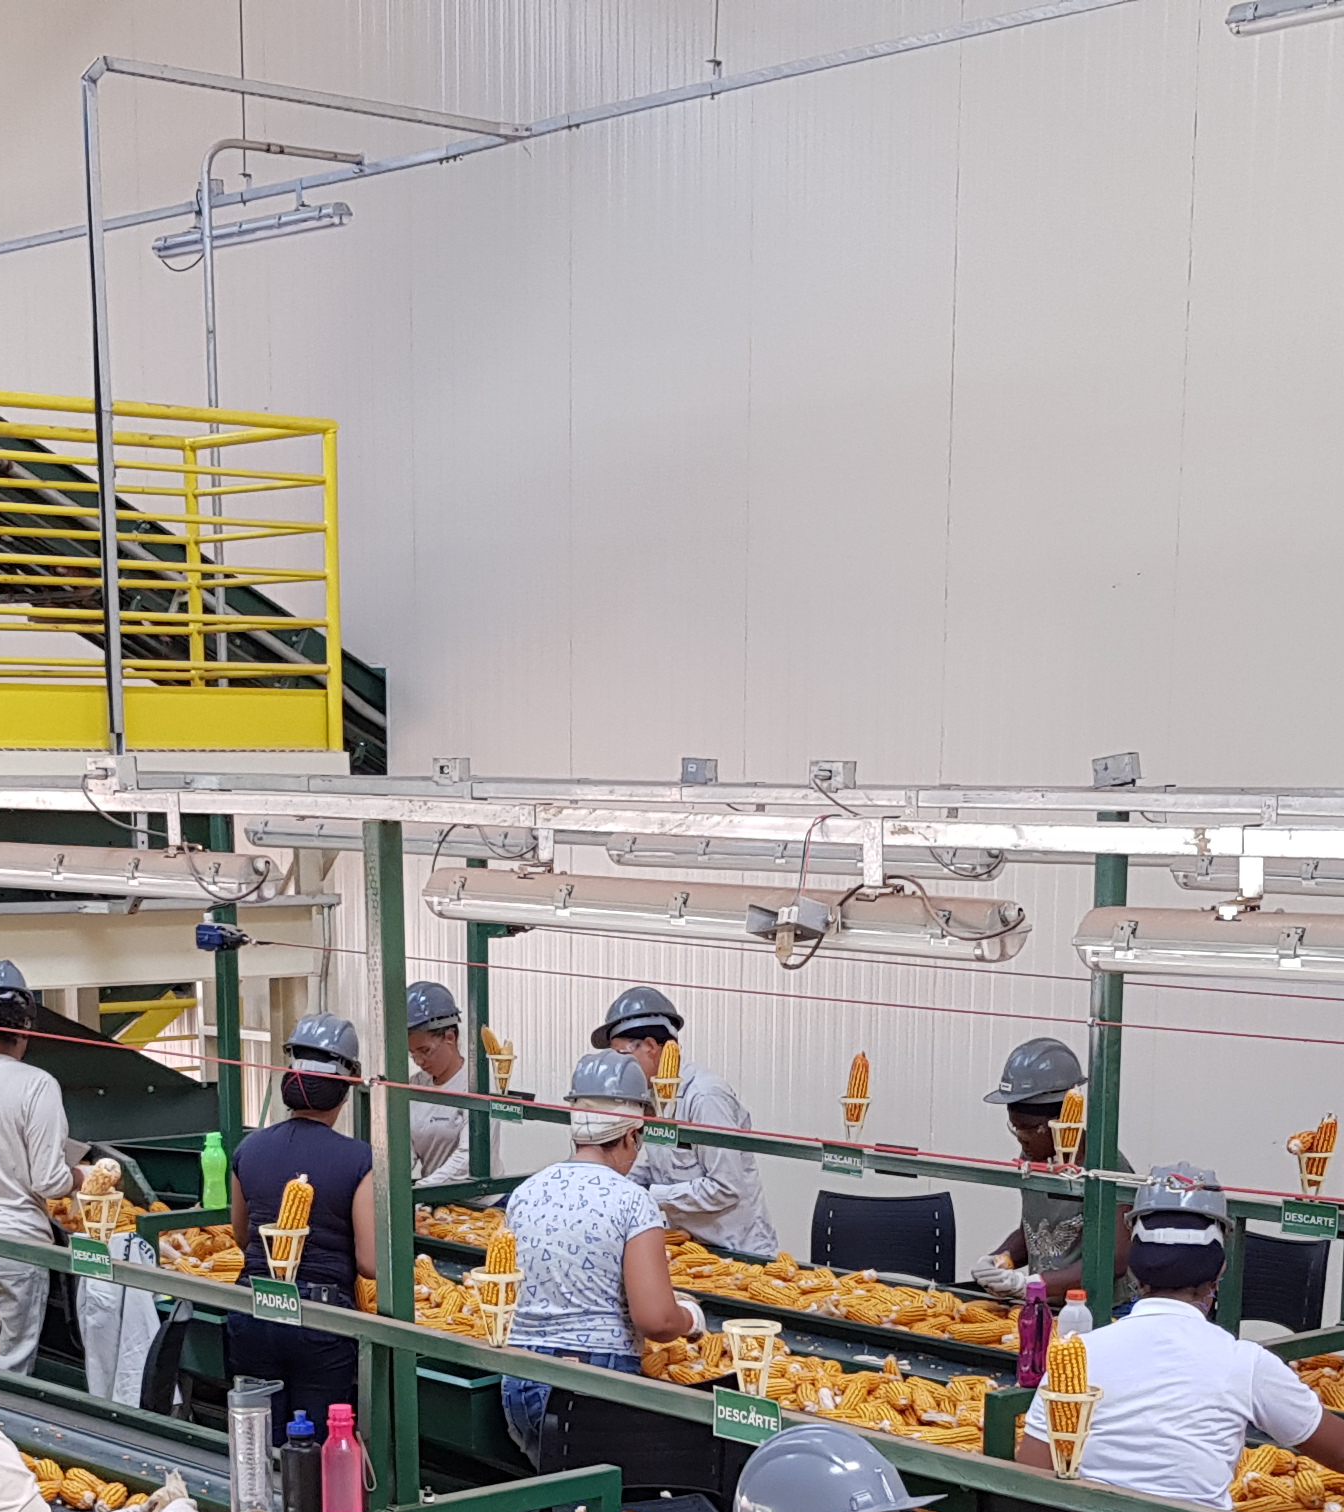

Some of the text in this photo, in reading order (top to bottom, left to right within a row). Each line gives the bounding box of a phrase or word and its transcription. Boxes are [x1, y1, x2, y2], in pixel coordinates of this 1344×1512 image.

[643, 1125, 676, 1140] PADRÃO
[824, 1152, 862, 1167] DESCARTE
[1284, 1211, 1335, 1228] DESCARTE
[73, 1249, 111, 1266] DESCARTE
[256, 1291, 297, 1312] PADRÃO
[717, 1404, 778, 1431] DESCARTE
